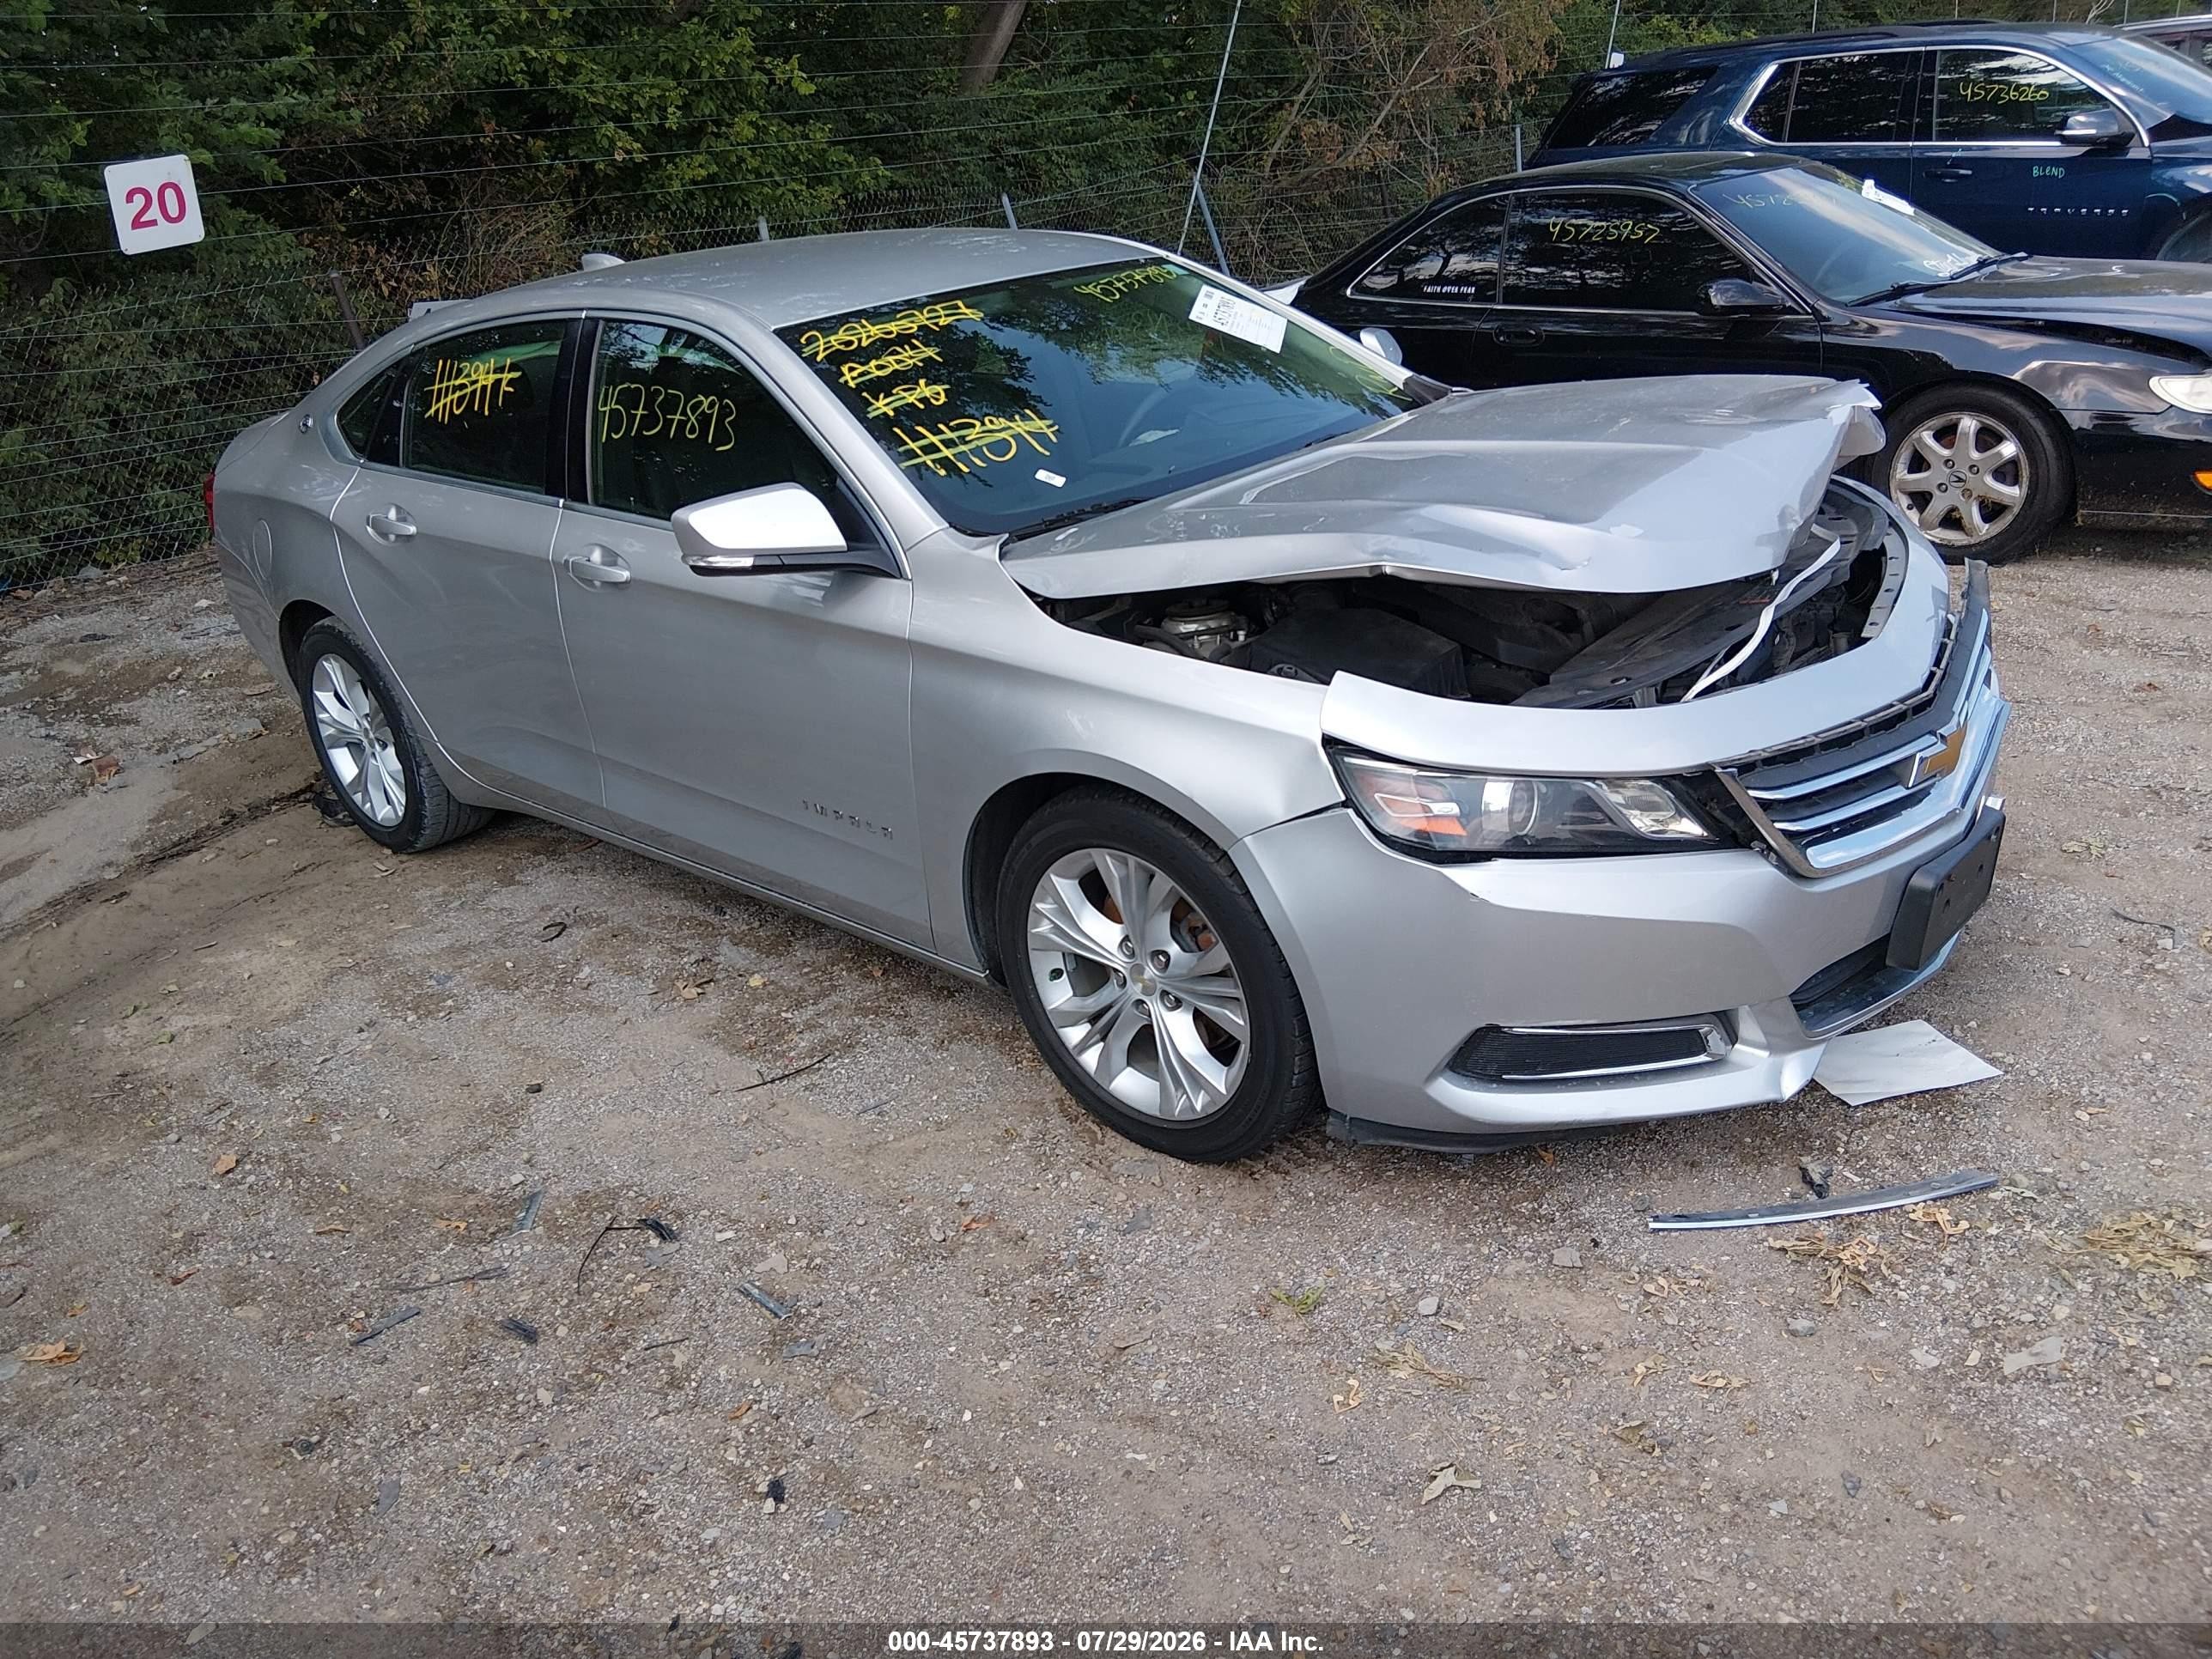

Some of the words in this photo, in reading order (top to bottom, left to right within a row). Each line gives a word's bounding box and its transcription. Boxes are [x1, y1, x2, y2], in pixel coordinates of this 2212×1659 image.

[1960, 82, 2050, 105] 45736260
[125, 180, 187, 231] 20
[599, 382, 737, 452] 45737893
